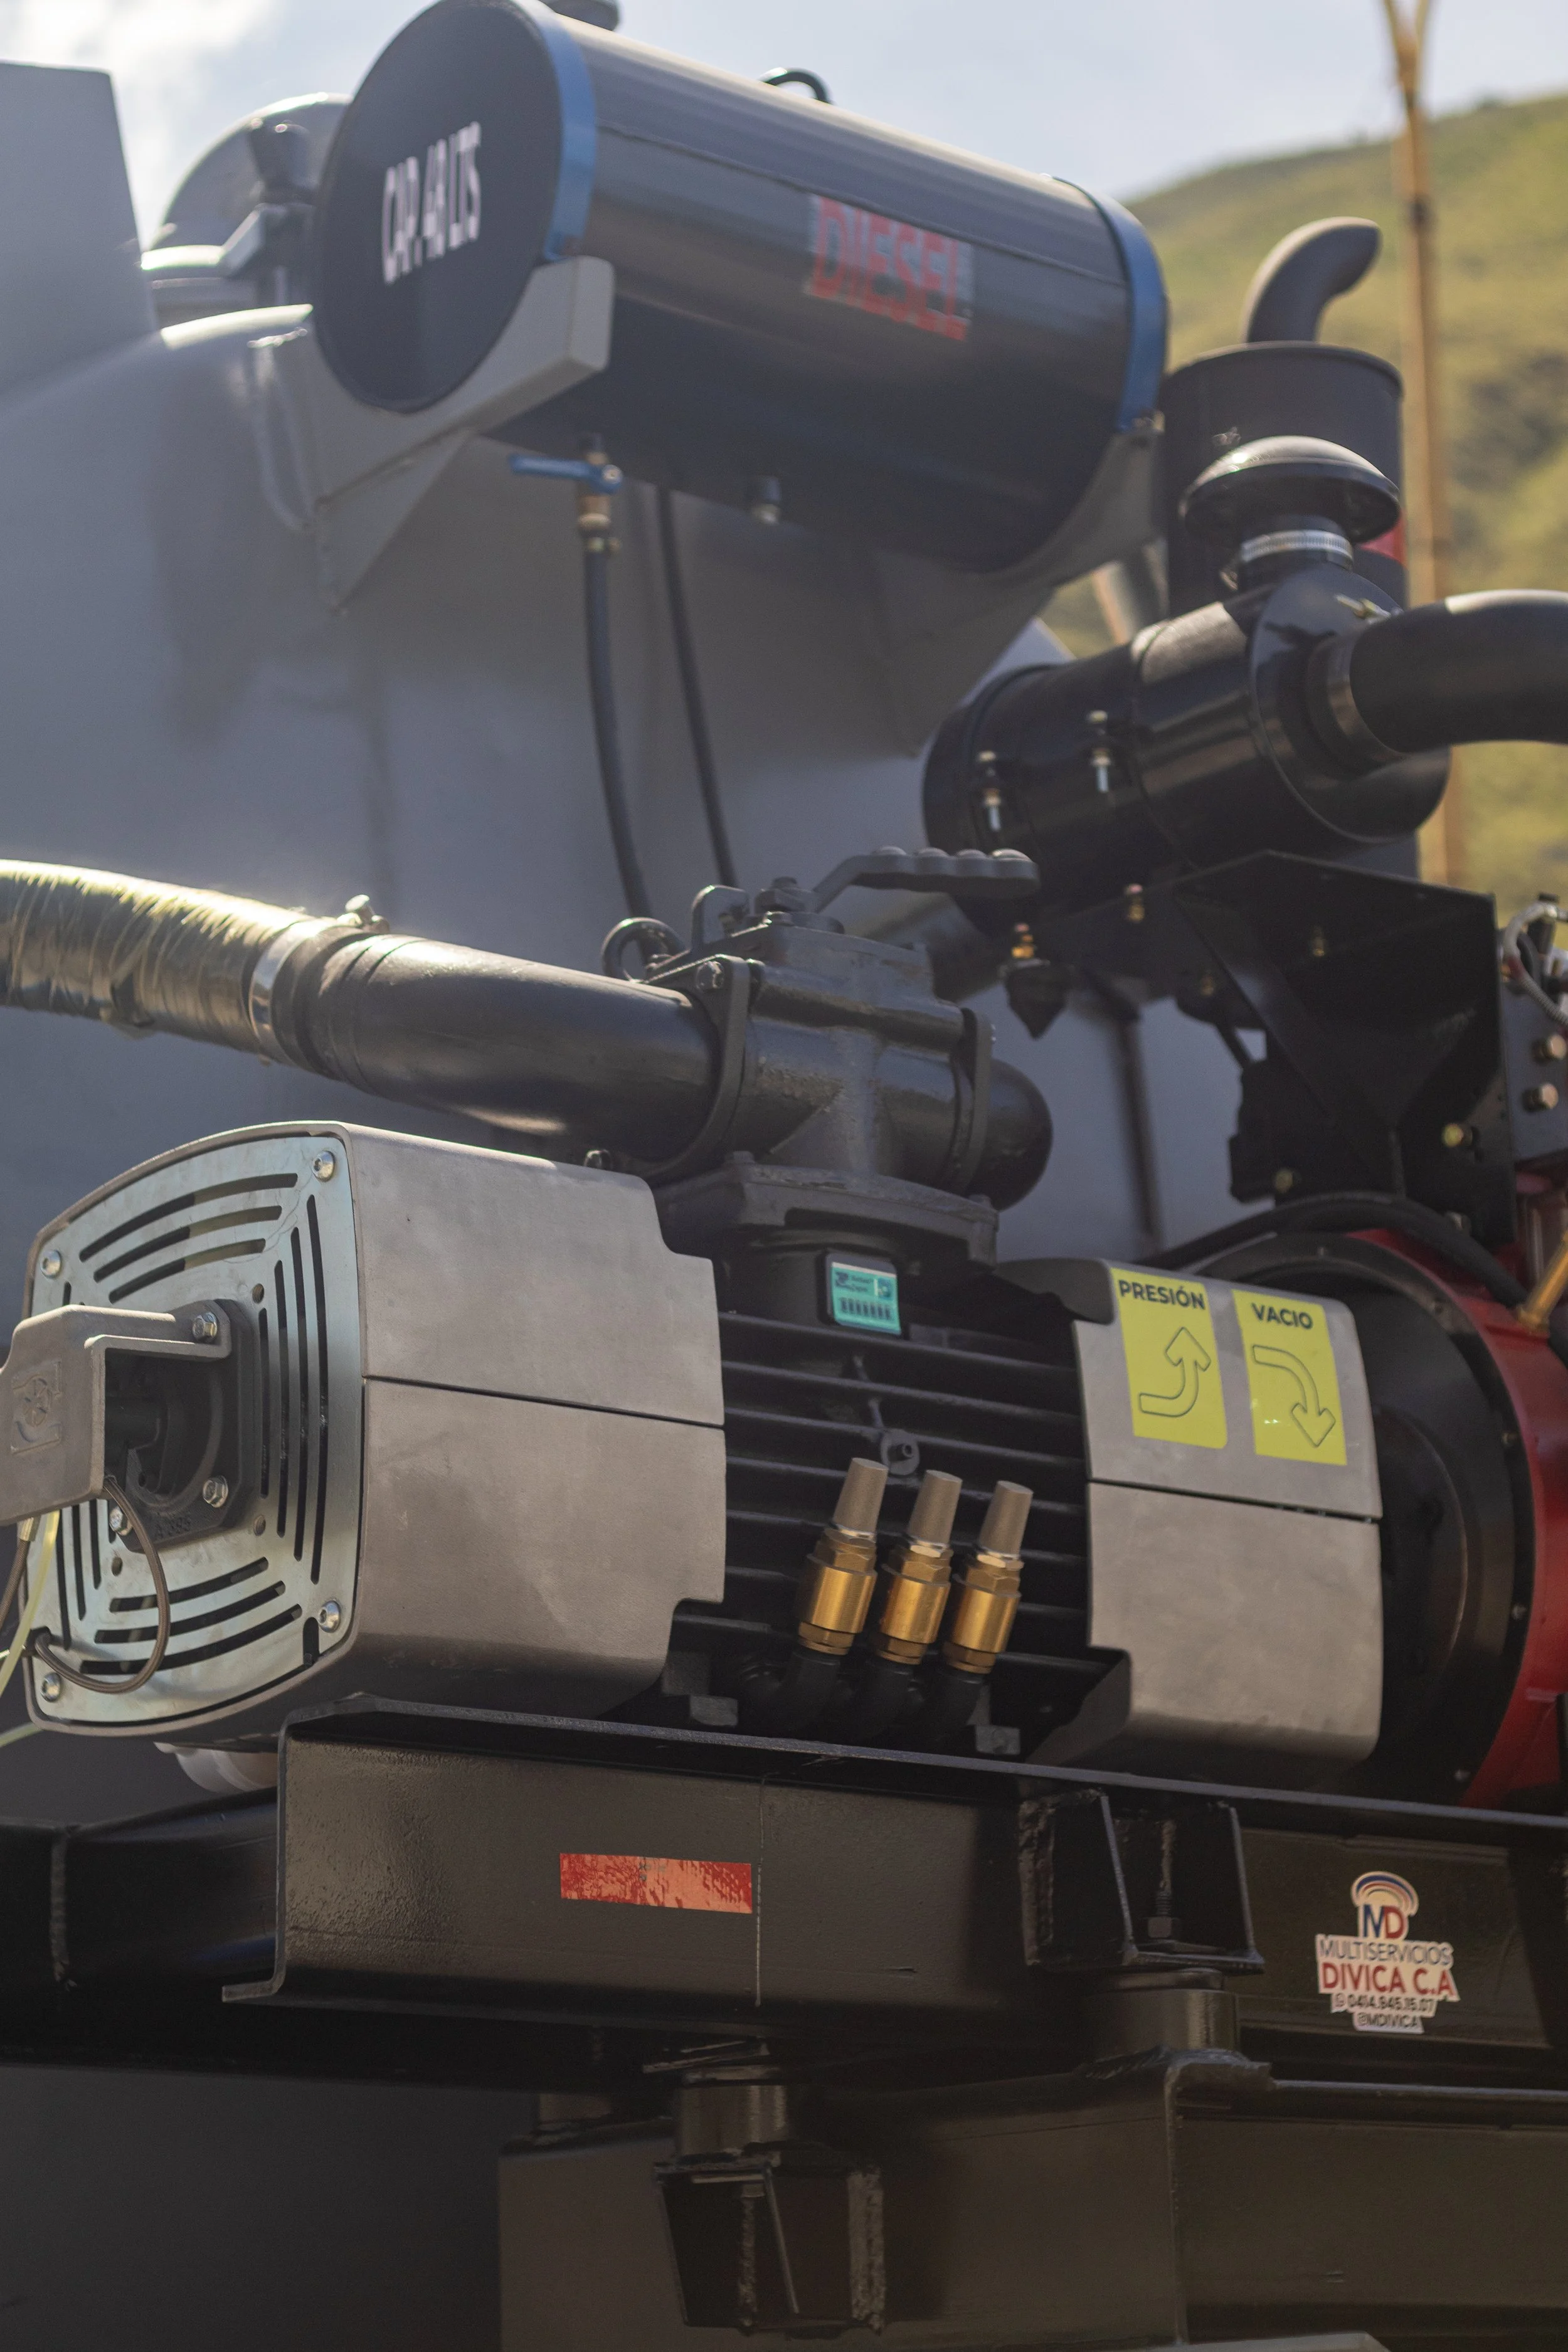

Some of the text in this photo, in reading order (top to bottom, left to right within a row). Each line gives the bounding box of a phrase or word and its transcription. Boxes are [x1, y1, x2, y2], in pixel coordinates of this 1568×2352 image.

[812, 196, 968, 341] DIESEL
[1118, 1279, 1205, 1310] PRESIÓN
[1251, 1302, 1313, 1330] VACIO
[1362, 1904, 1404, 1939] MD
[1320, 1939, 1452, 1966] MULTISERVICIOS
[1322, 1962, 1407, 1994] DIVICA
